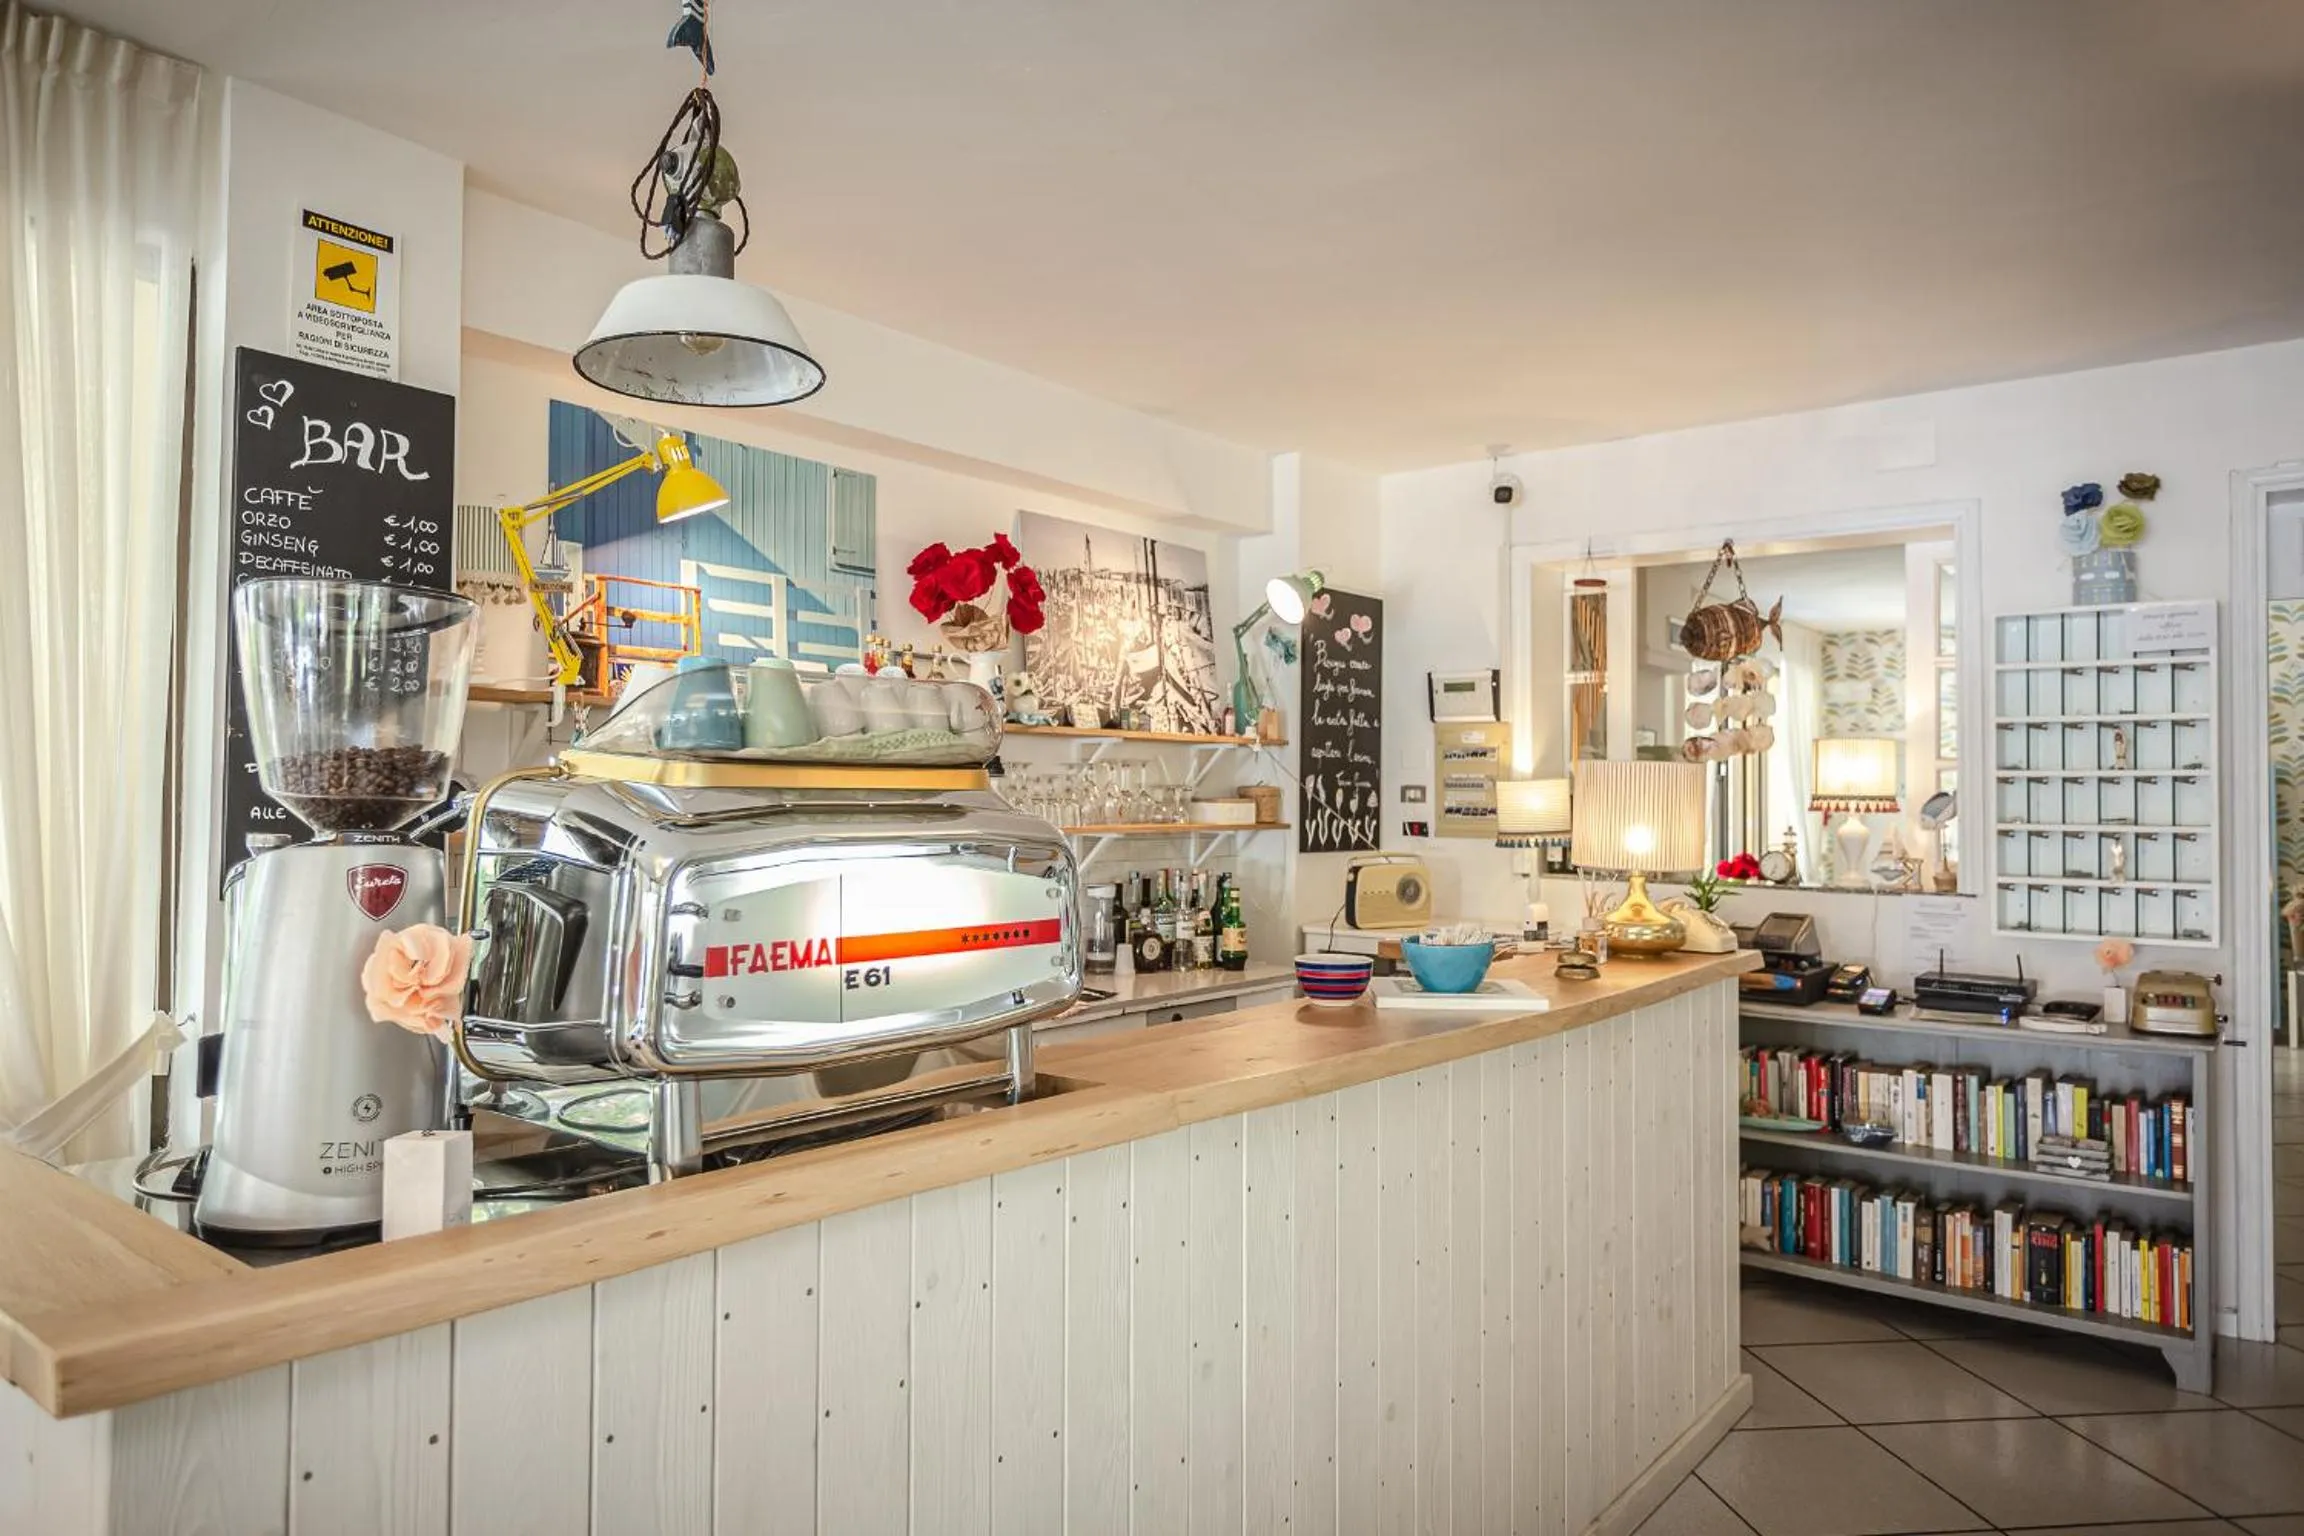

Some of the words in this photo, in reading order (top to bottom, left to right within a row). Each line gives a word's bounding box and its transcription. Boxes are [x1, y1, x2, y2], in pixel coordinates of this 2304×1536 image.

[308, 214, 388, 249] ATTENZIONE!
[306, 303, 328, 315] AREA
[330, 310, 384, 328] SOTTOPOSTA
[298, 331, 332, 346] RAGIONI
[334, 340, 342, 348] DI
[344, 341, 389, 359] SICUREZZA
[336, 331, 352, 341] PER
[290, 415, 430, 480] BAR
[241, 510, 291, 529] ORZO
[401, 537, 440, 555] 1,00
[402, 516, 438, 534] 1,00
[240, 529, 320, 557] GINSENG
[399, 558, 434, 575] 1,00
[353, 835, 400, 843] ZENITH
[730, 938, 833, 976] FAEMA
